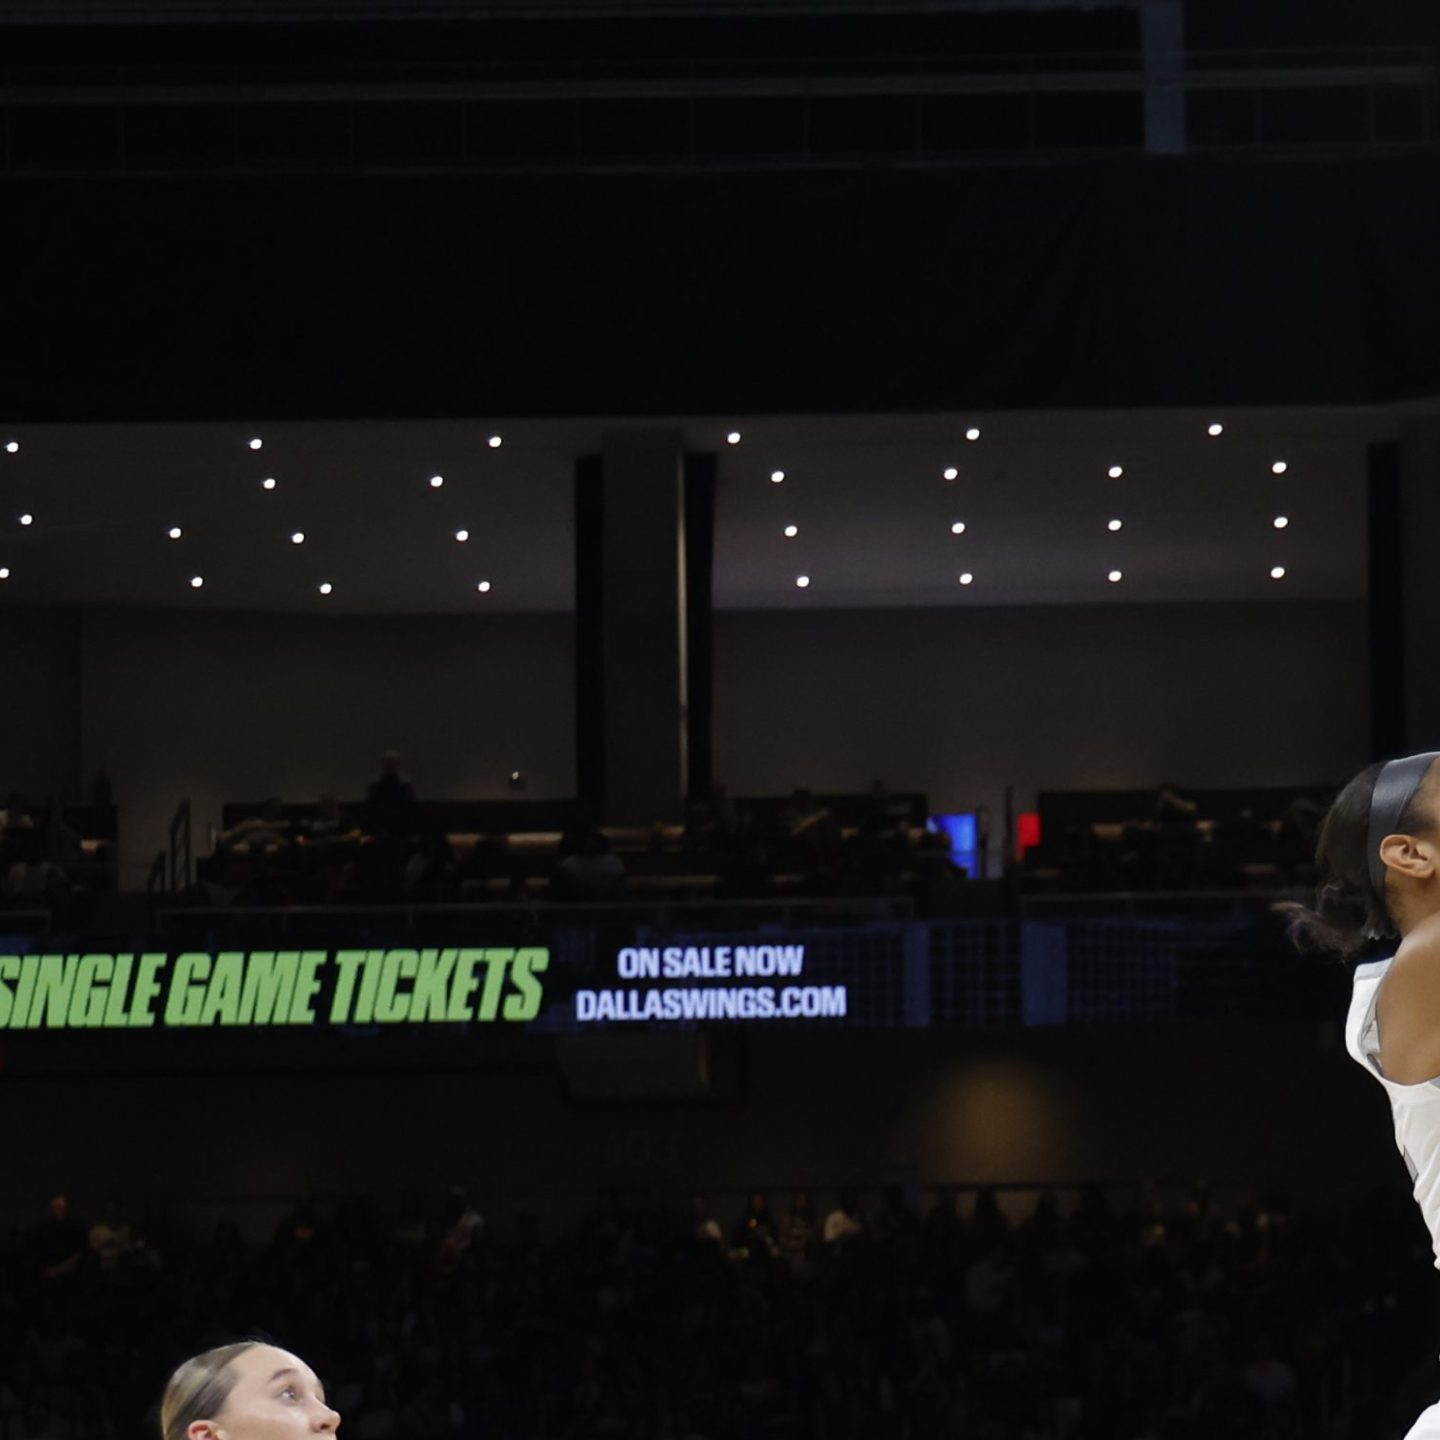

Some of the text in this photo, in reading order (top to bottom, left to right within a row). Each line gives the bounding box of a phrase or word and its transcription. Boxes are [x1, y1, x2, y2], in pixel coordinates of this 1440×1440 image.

[617, 945, 804, 979] ON SALE NOW
[0, 947, 550, 1028] SINGLE GAME TICKETS
[575, 986, 847, 1021] DALLASWINGS.COM
